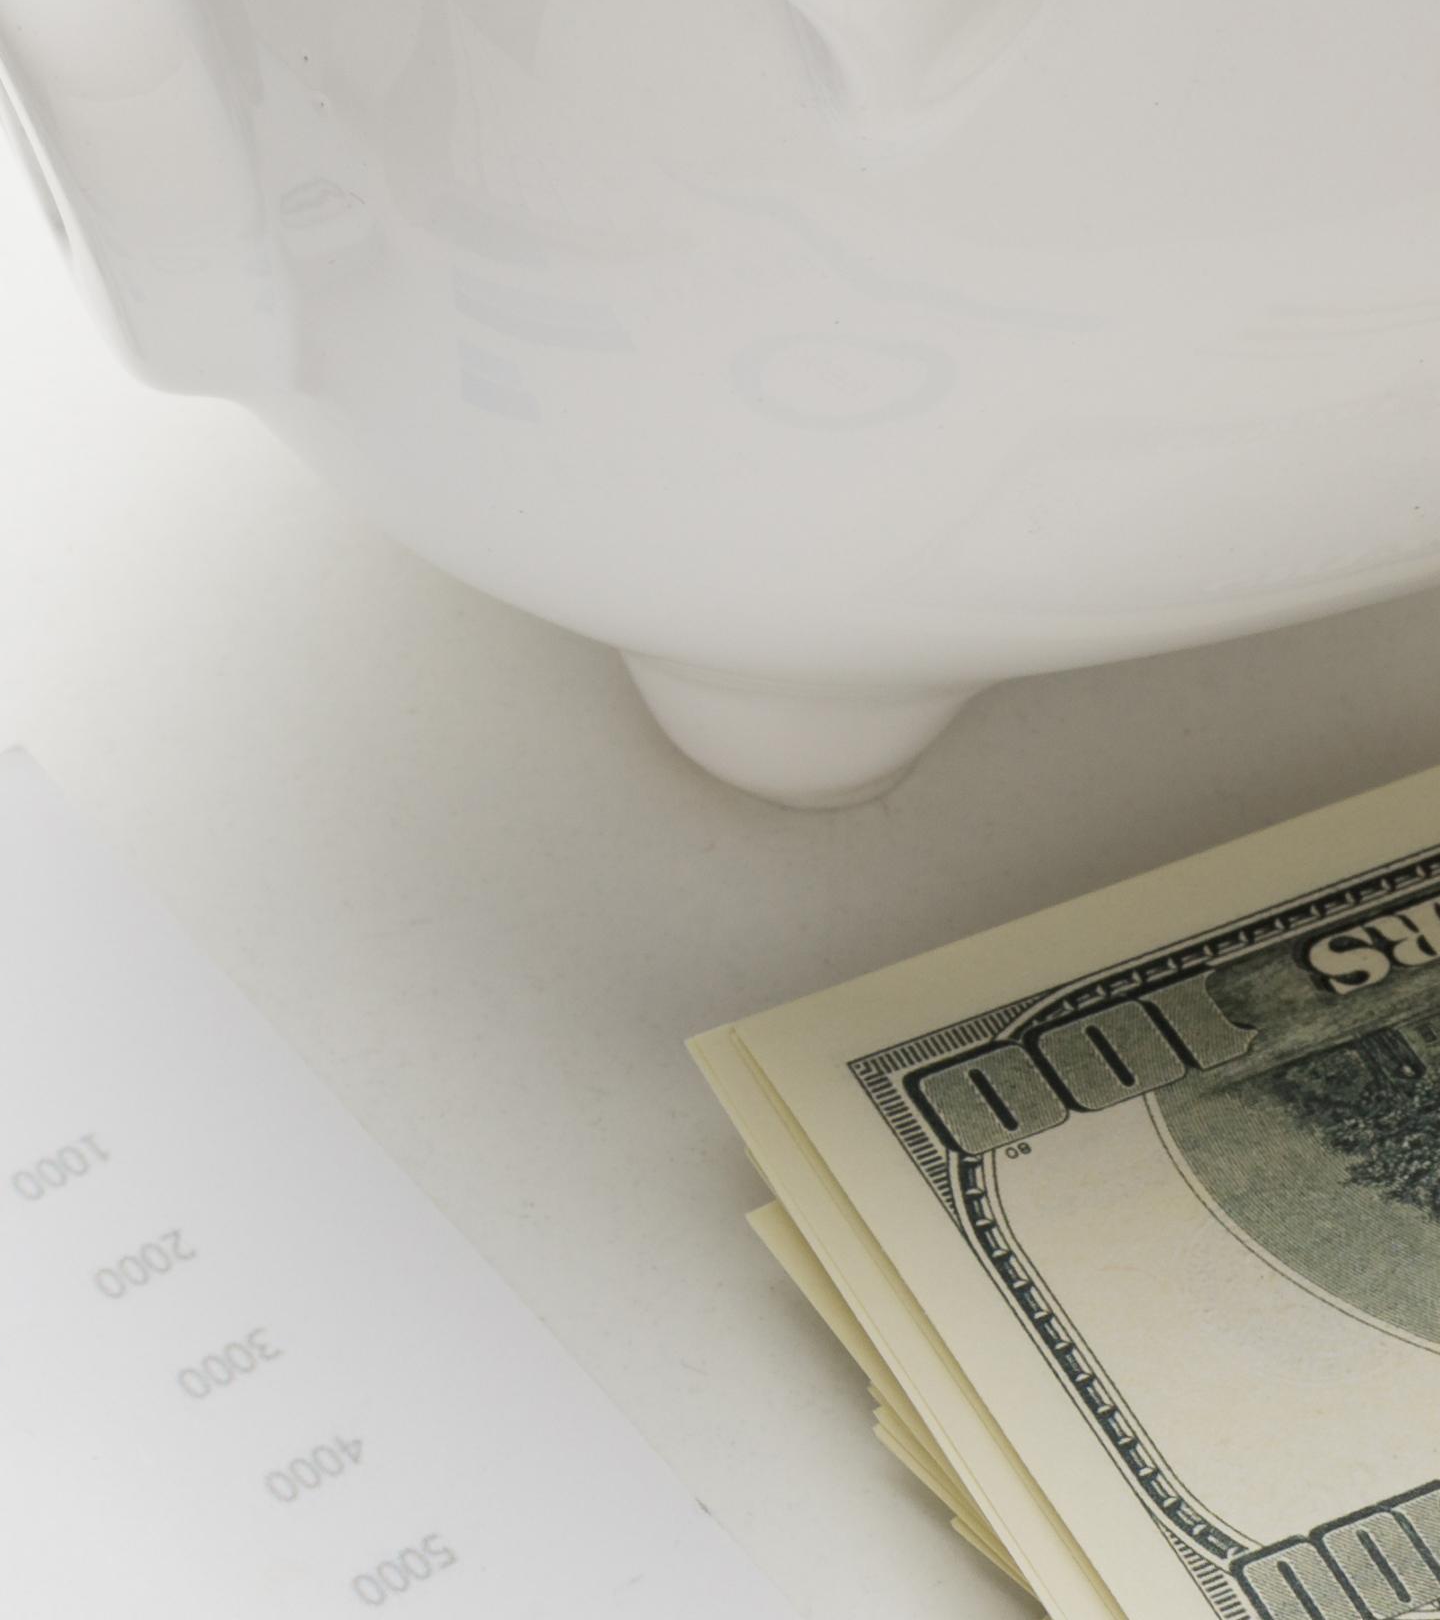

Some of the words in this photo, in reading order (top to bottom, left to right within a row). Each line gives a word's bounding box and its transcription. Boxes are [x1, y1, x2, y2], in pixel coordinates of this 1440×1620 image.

[908, 970, 1259, 1155] 100
[10, 1133, 110, 1202] 1000
[93, 1228, 198, 1300] 2000
[176, 1327, 284, 1400] 3000
[264, 1436, 364, 1504] 4000
[350, 1532, 459, 1607] 5000
